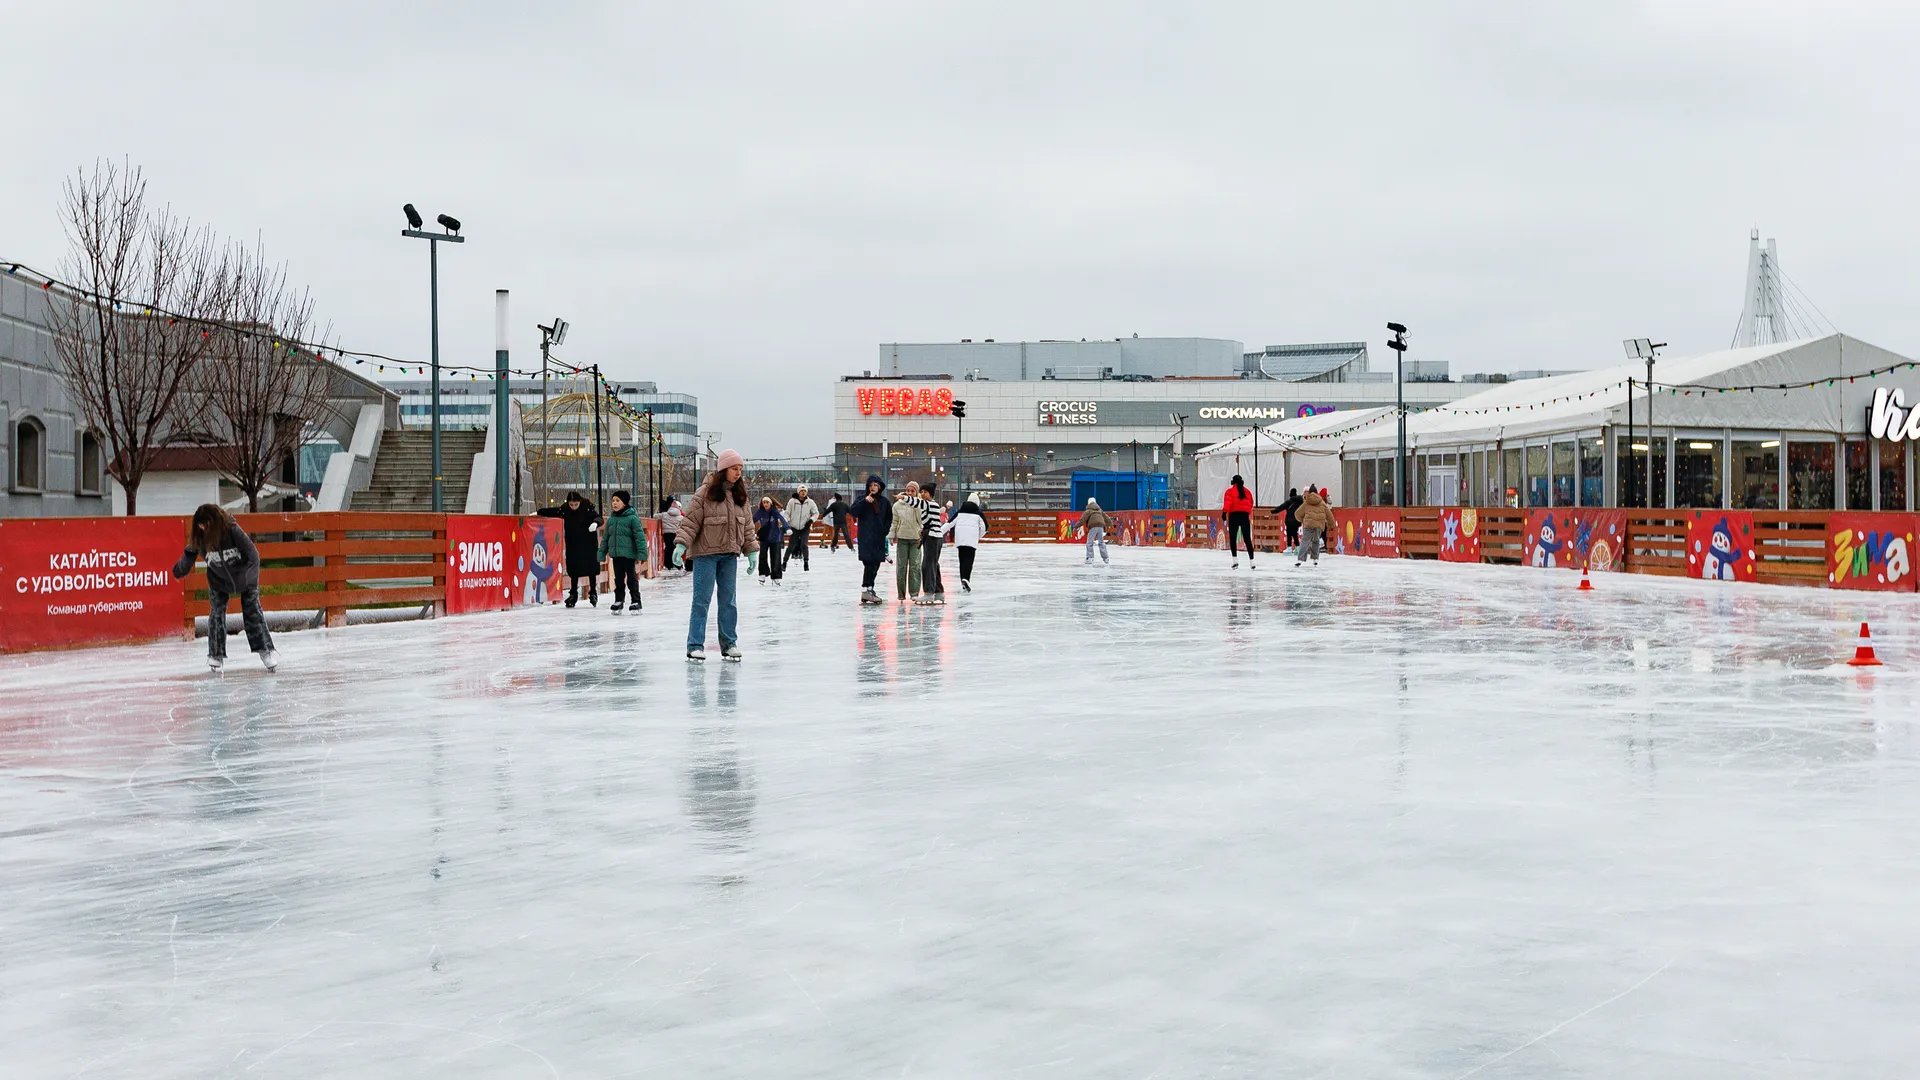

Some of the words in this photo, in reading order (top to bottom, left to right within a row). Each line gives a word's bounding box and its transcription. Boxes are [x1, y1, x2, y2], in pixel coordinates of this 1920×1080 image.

[857, 388, 952, 416] VEGAS
[1040, 401, 1097, 412] CROCUS
[1199, 407, 1285, 419] СТОКМАНН
[50, 549, 137, 570] КАТАЙТЕСЬ
[1834, 529, 1910, 583] Зима
[16, 577, 28, 593] С
[32, 571, 169, 594] УДОВОЛЬСТВИЕМ!
[47, 603, 87, 616] Команда
[88, 600, 143, 615] губернатора
